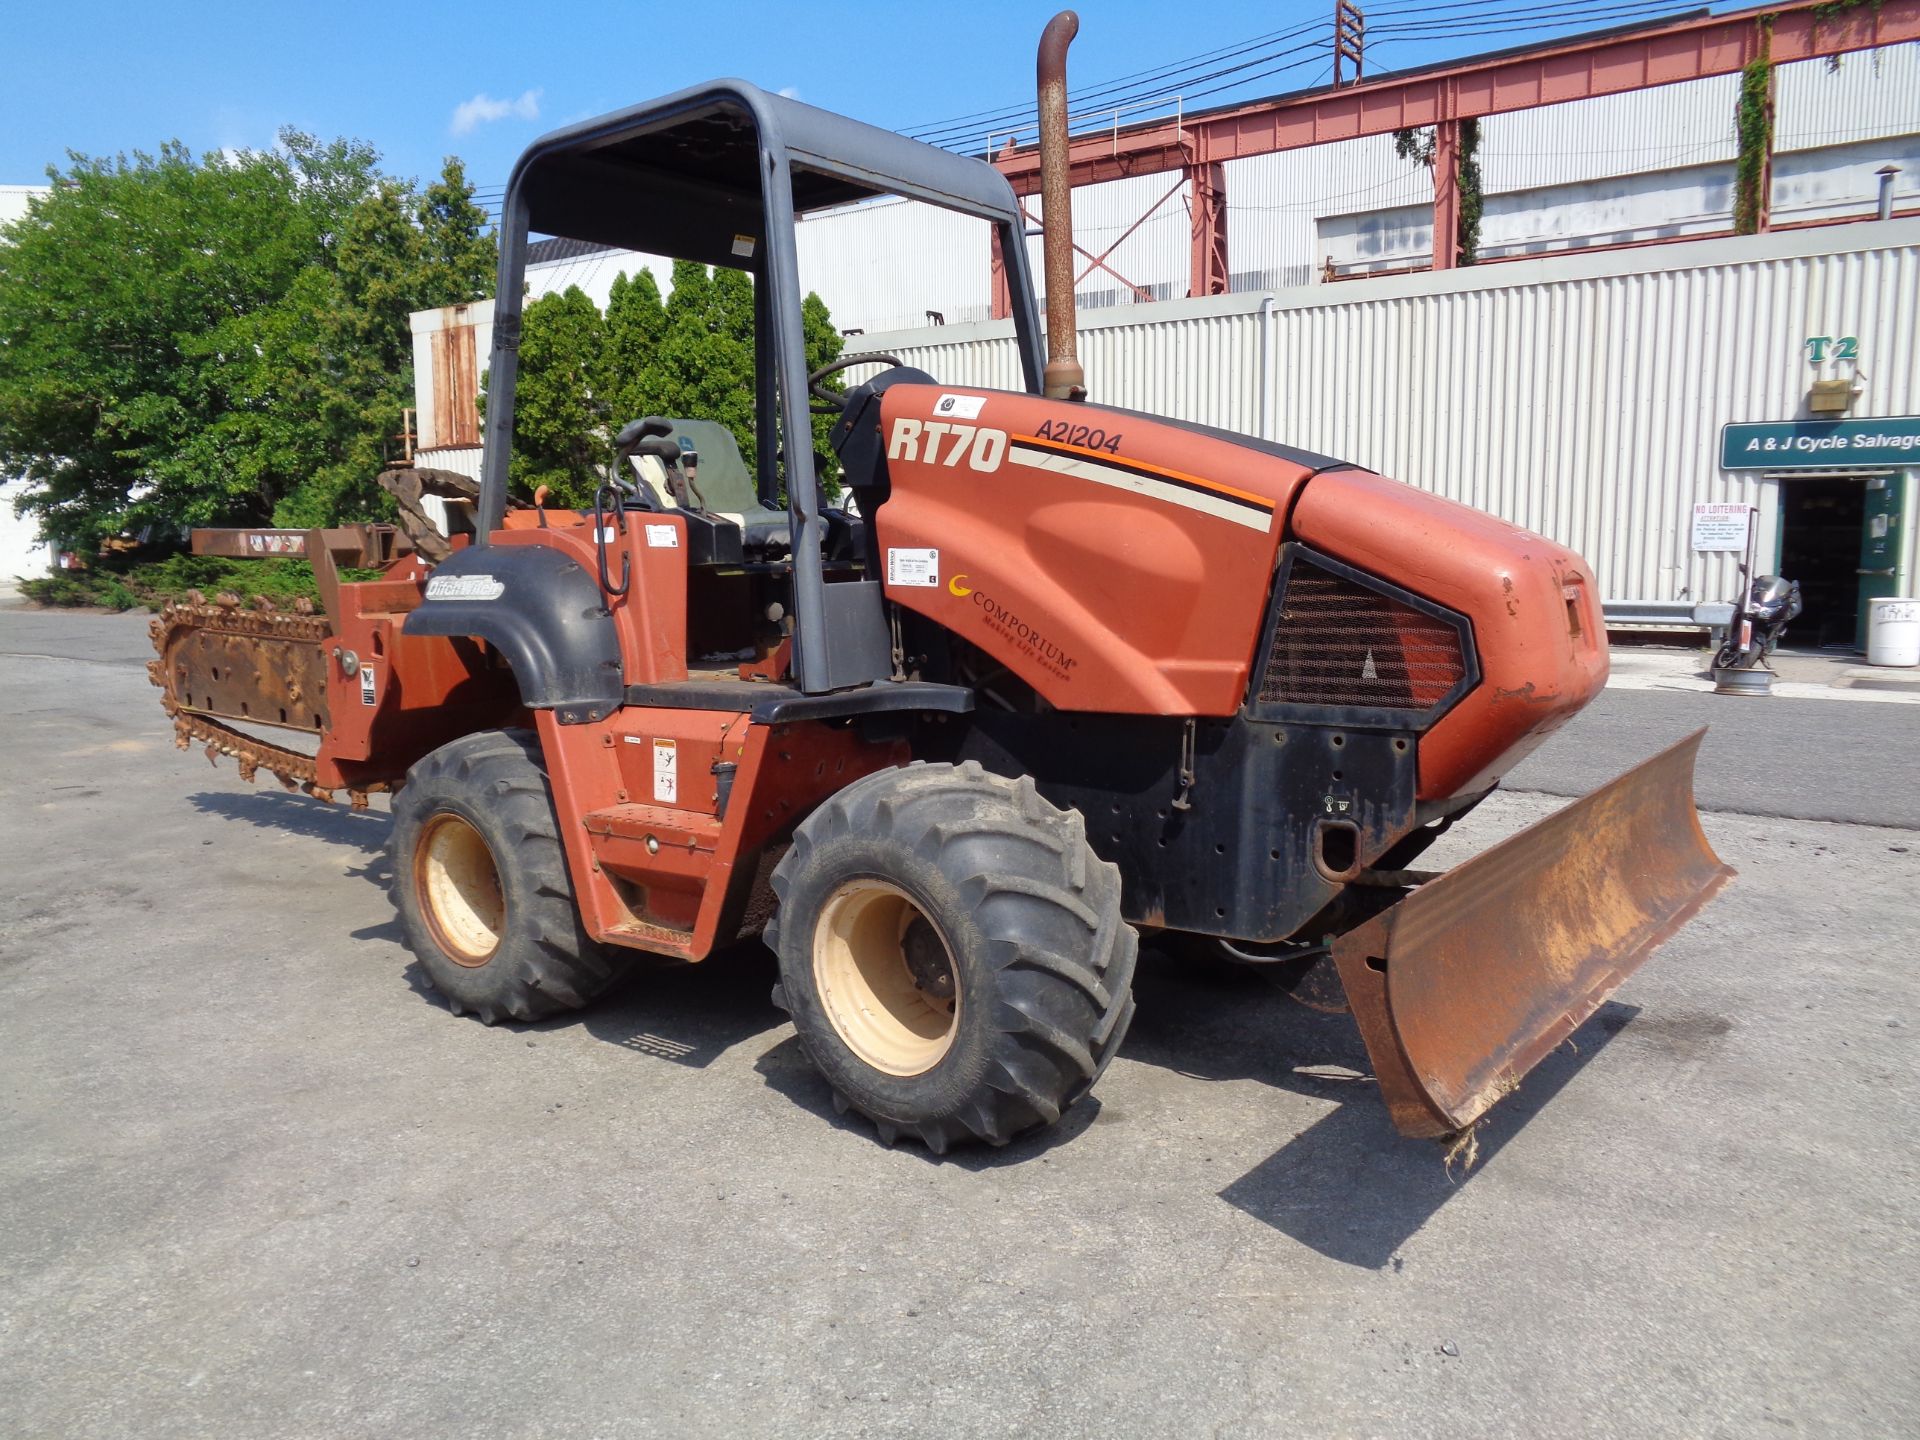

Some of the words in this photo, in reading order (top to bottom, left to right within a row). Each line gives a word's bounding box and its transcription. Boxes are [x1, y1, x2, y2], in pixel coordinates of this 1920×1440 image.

[1805, 335, 1858, 361] T2
[887, 417, 1007, 473] RT70
[1034, 419, 1123, 455] A21204
[1746, 437, 1760, 450] A
[1764, 437, 1777, 450] &
[1781, 437, 1793, 450] J
[1796, 435, 1848, 453] Cycle
[1696, 505, 1705, 514] NO
[1709, 504, 1746, 514] LOITERING
[973, 591, 1073, 671] COMPORIUM
[983, 615, 1014, 645] Making
[1017, 641, 1035, 656] Life
